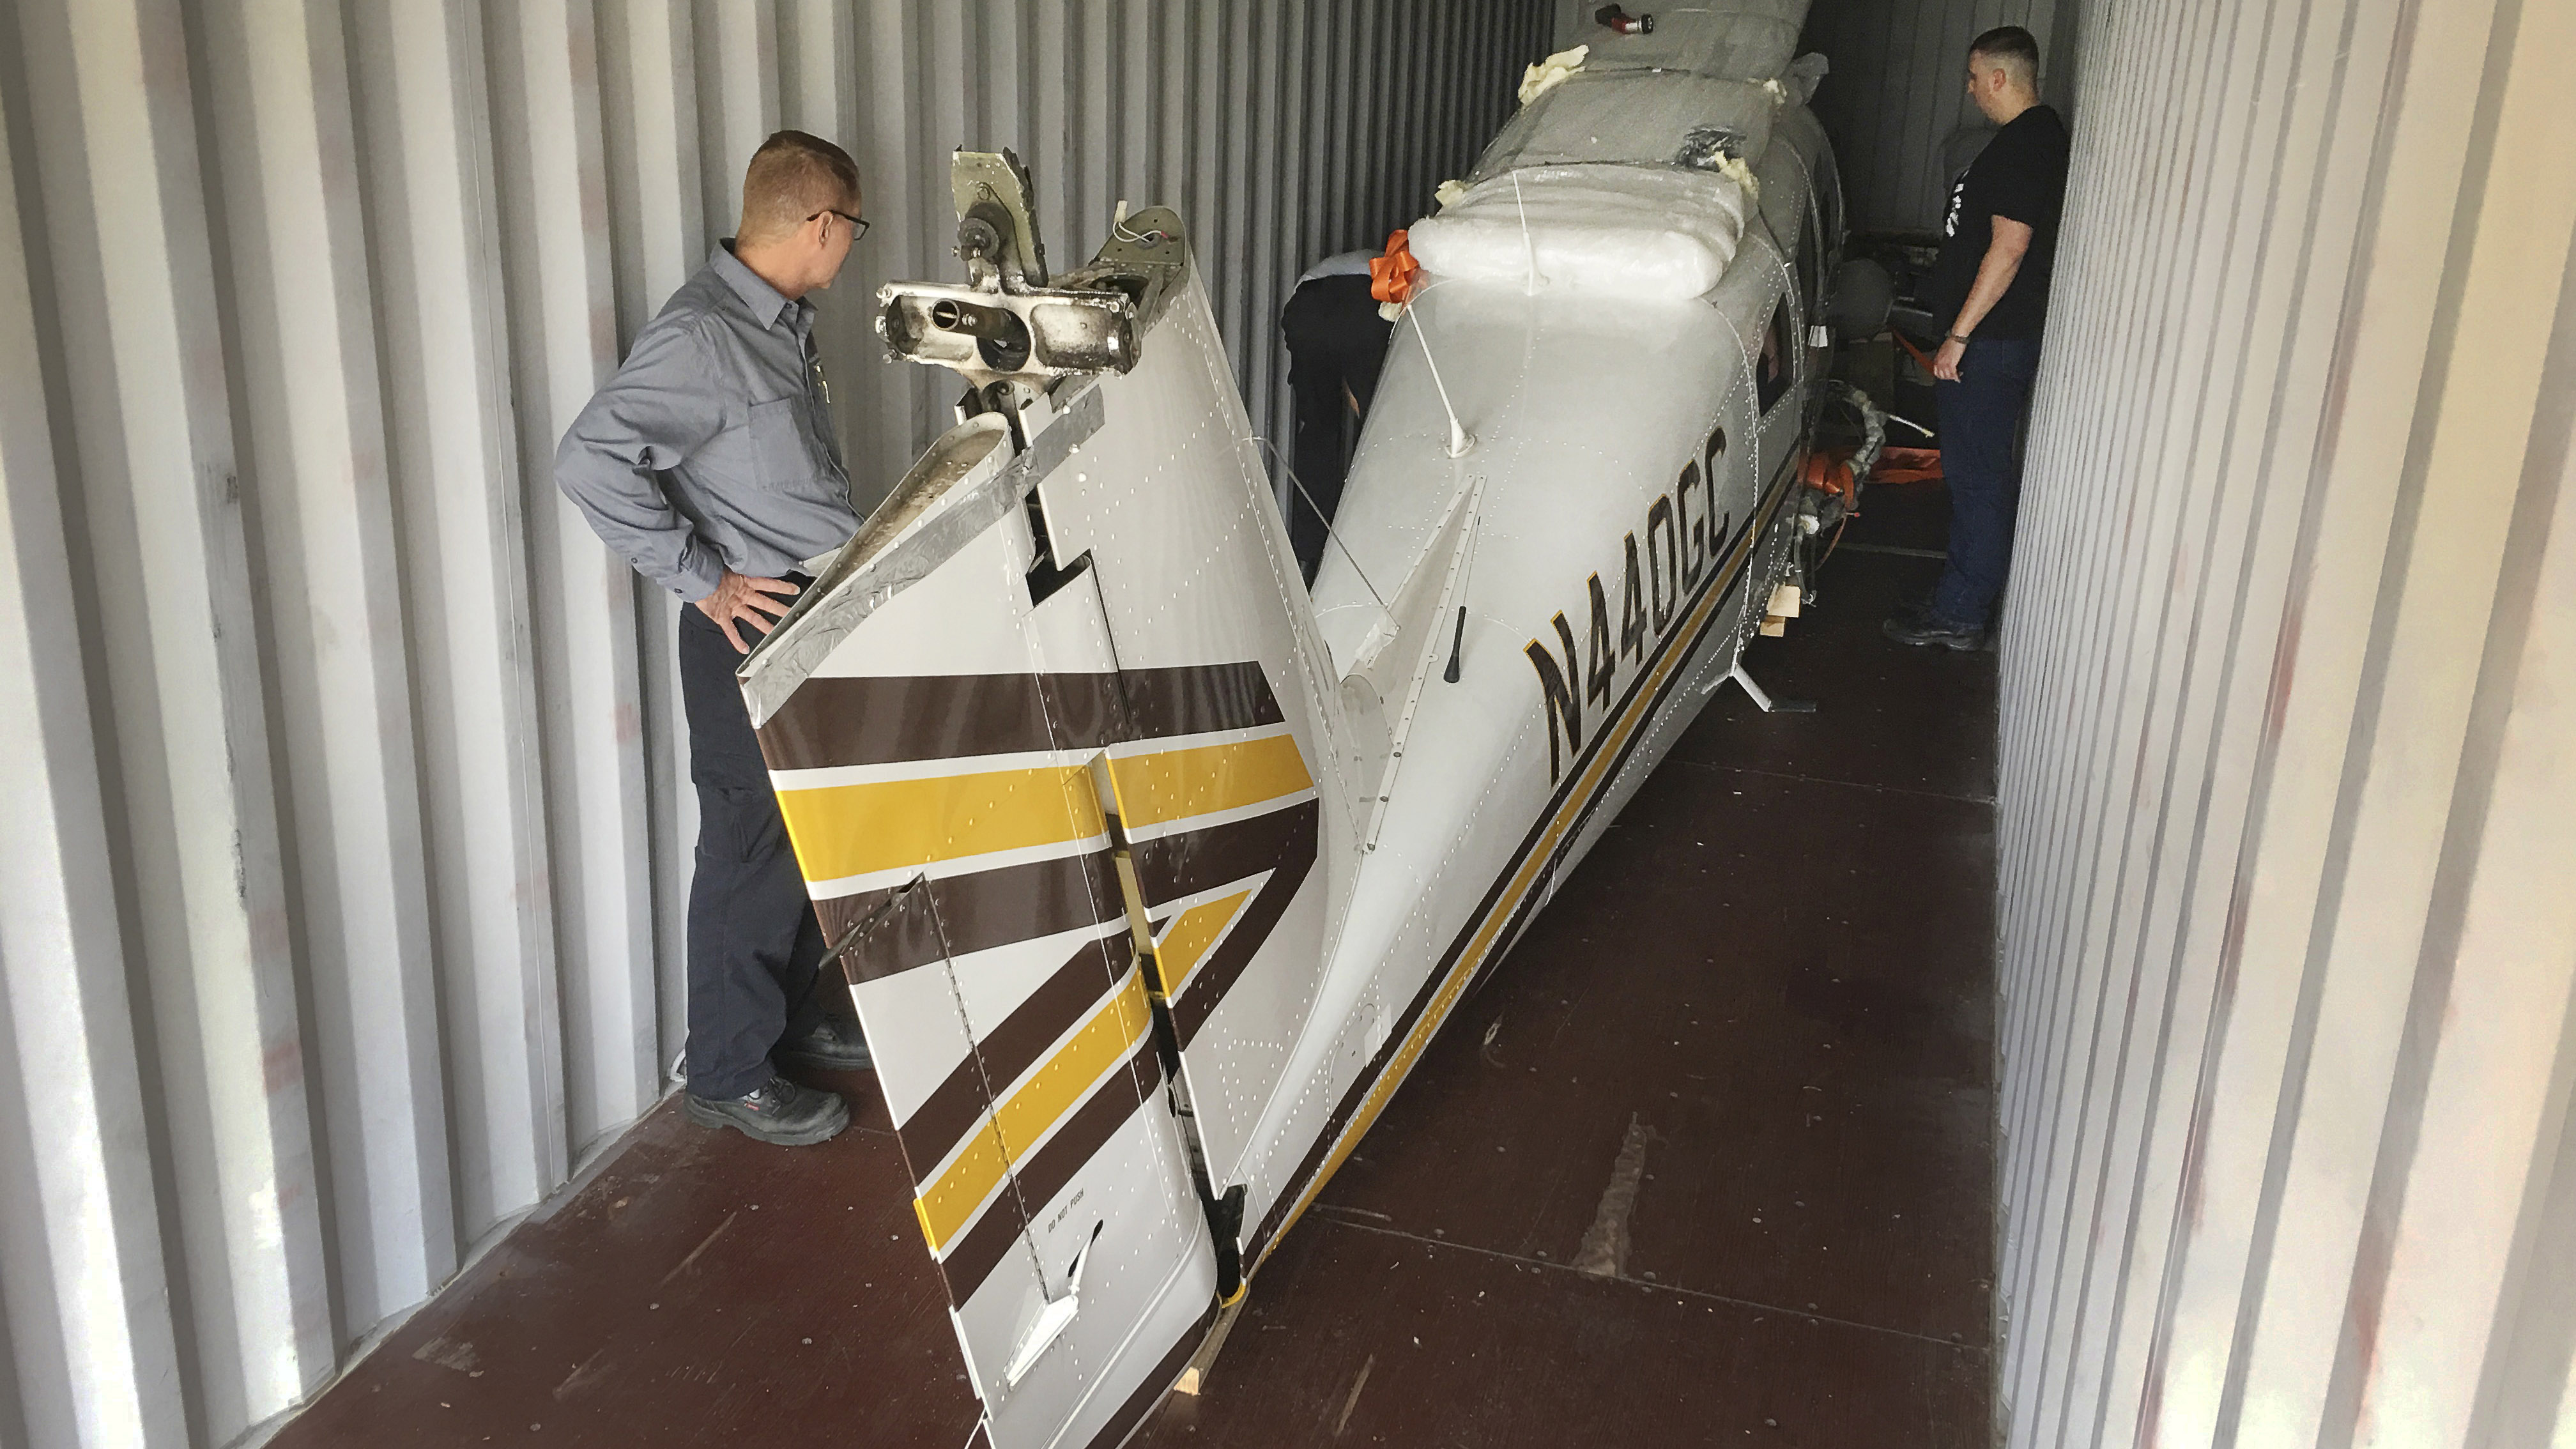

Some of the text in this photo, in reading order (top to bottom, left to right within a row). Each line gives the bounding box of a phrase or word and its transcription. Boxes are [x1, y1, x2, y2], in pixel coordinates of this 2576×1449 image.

[1523, 426, 1729, 788] N440GC
[1048, 1187, 1084, 1234] DO NOT PUSH
